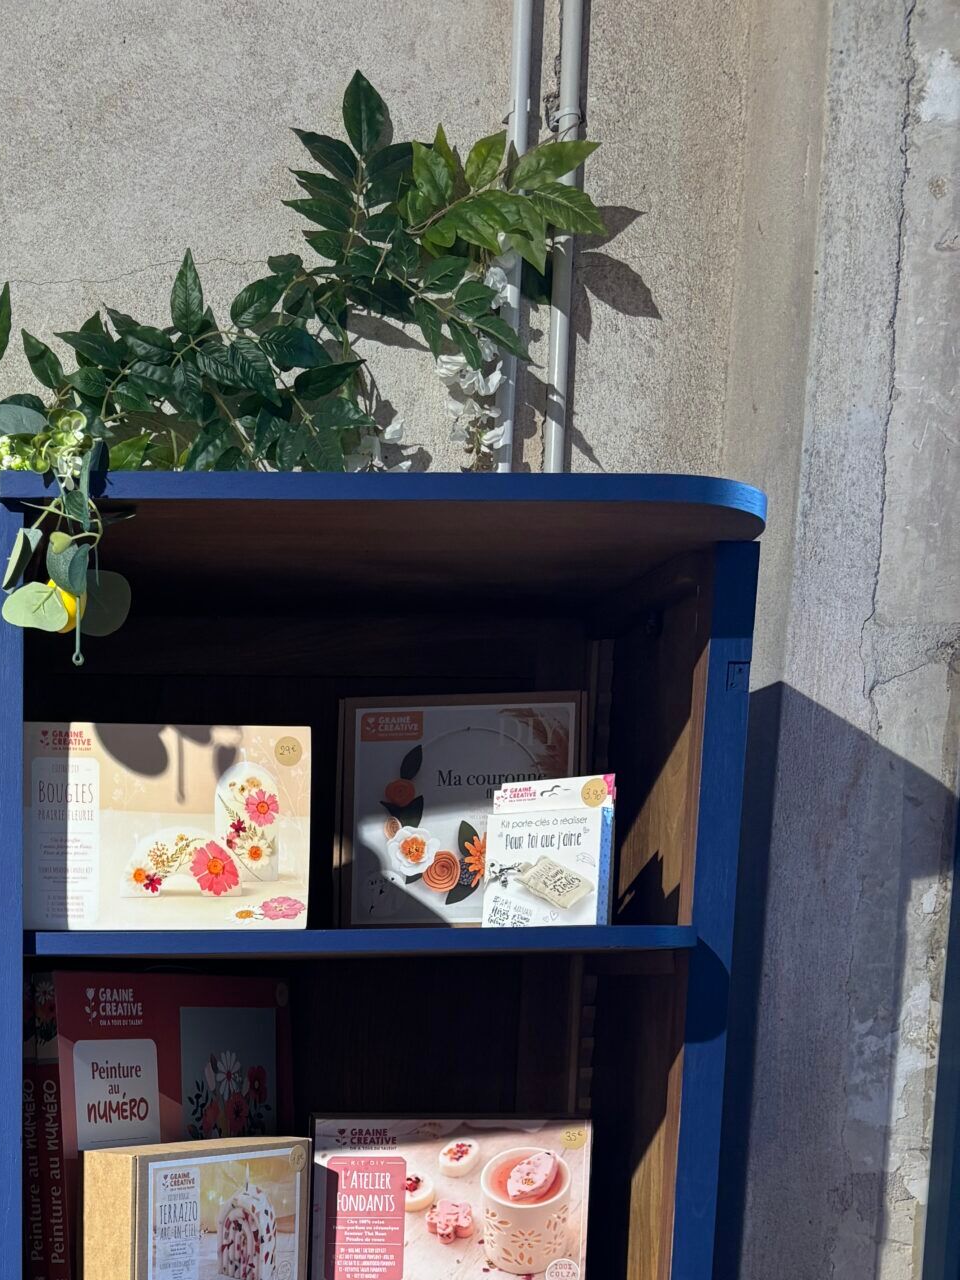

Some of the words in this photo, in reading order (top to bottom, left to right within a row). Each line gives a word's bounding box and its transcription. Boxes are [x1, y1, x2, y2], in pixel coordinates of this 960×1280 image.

[52, 729, 85, 738] GRAINE
[52, 738, 92, 746] CREATIVE
[437, 769, 461, 786] Ma
[38, 780, 94, 804] BOUGIES
[501, 820, 509, 829] Kit
[99, 988, 134, 1001] GRAINE
[99, 1003, 143, 1016] CREATIVE
[91, 1060, 142, 1081] Peinture
[108, 1083, 120, 1094] au
[350, 1128, 388, 1136] GRAINE
[350, 1136, 397, 1145] CREATIVE
[28, 1155, 39, 1178] au
[49, 1157, 60, 1180] au
[170, 1171, 191, 1180] GRAINE
[170, 1177, 195, 1187] CREATIVE
[341, 1170, 391, 1190] L'ATELIER
[159, 1200, 198, 1225] TERRAZZO
[30, 1184, 44, 1262] Peinture
[49, 1186, 65, 1264] Peinture
